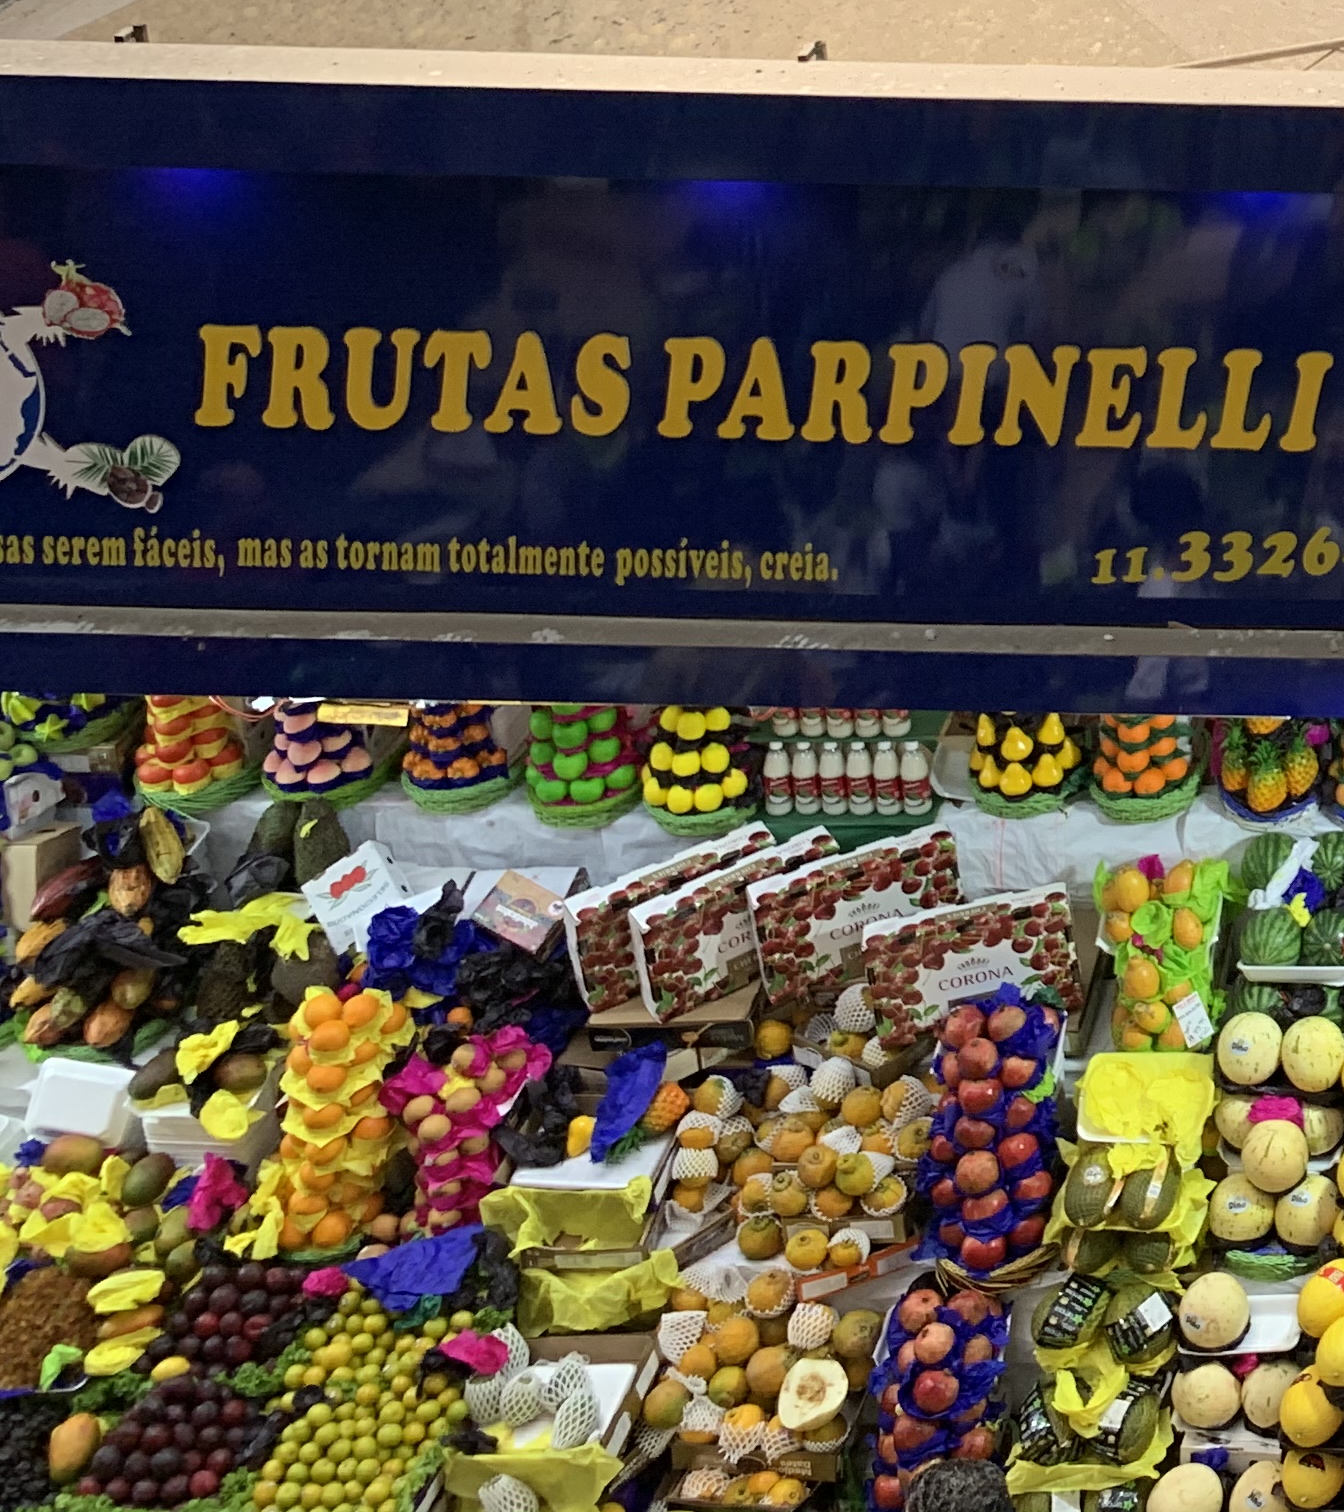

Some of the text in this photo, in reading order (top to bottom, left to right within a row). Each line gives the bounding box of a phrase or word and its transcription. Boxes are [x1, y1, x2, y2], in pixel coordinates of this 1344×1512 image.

[194, 324, 1334, 452] FRUTAS PARPINELLI
[42, 536, 127, 566] serem
[133, 528, 225, 572] fáceis,
[236, 538, 293, 568] mas
[299, 540, 328, 569] as
[335, 537, 441, 573] tornam
[447, 536, 605, 577] totalmente
[615, 541, 753, 585] possíveis,
[760, 545, 838, 582] creia.
[938, 965, 1014, 992] CORONA
